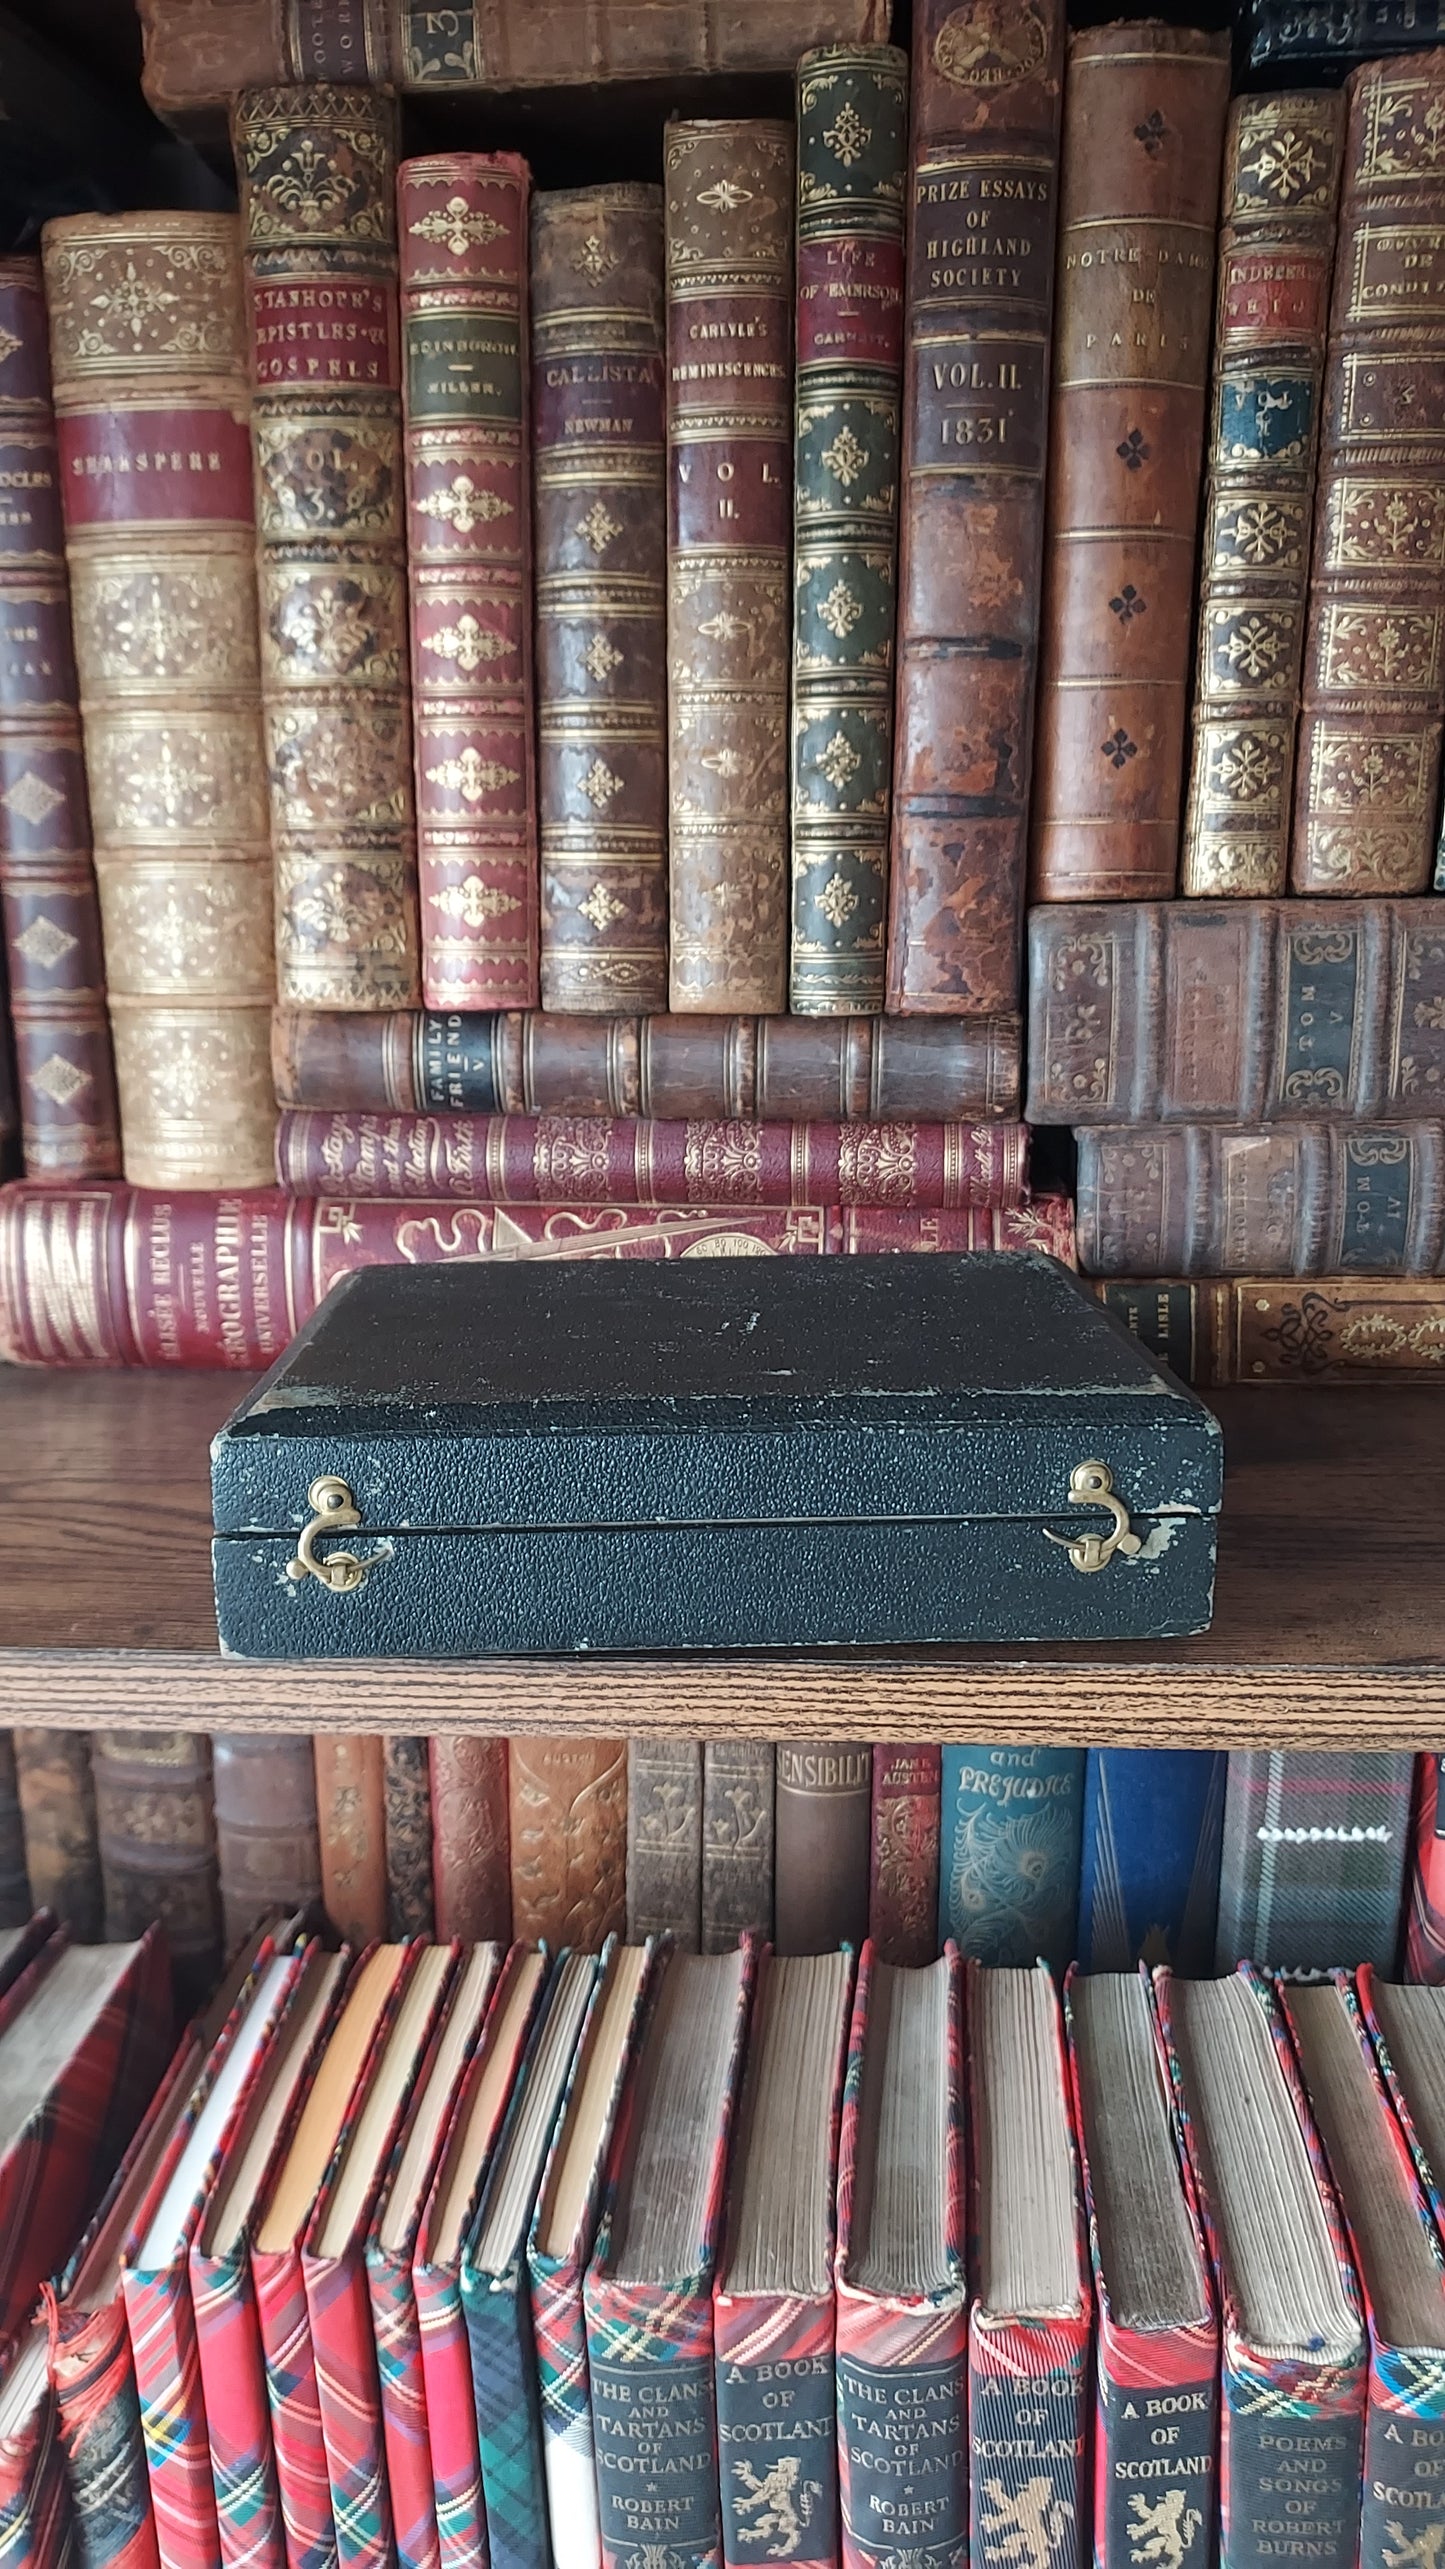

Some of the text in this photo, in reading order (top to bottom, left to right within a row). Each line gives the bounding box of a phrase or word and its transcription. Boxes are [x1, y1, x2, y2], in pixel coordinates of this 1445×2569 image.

[917, 180, 1047, 203] PRIZE ESSAYS
[966, 210, 991, 229] OF
[927, 237, 1032, 260] HIGHLAND
[827, 251, 875, 267] LIFE
[1066, 248, 1140, 270] NOTRE
[1405, 254, 1433, 268] DE
[931, 269, 1021, 289] SOCIETY
[254, 288, 382, 313] STANHOPE'S
[800, 285, 818, 299] OF
[1133, 288, 1155, 303] DE
[689, 319, 768, 339] CARLYLE'S
[1087, 333, 1188, 349] PARIS
[257, 357, 378, 378] GOSPELS
[546, 364, 652, 387] CALLISTA
[933, 363, 993, 391] VOL.
[565, 418, 634, 434] NEWMAN
[941, 417, 1007, 446] 1831
[428, 1019, 445, 1101] FAMILY
[447, 1014, 464, 1108] FRIEND
[472, 1059, 485, 1072] V
[150, 1203, 173, 1285] RECLUS
[250, 1214, 275, 1355] UNIVERSELLE
[1157, 1293, 1169, 1339] LISLE
[890, 1757, 932, 1771] JANE
[990, 1747, 1041, 1767] and
[777, 1749, 870, 1787] ENSIBILIT
[882, 1769, 938, 1785] AUSTEN
[725, 2357, 829, 2385] A BOOK
[592, 2379, 713, 2403] THE CLANS
[844, 2374, 964, 2405] THE CLANS
[980, 2374, 1085, 2398] A BOOK
[762, 2390, 796, 2409] OF
[1121, 2392, 1208, 2420] A BOOK
[629, 2406, 669, 2419] AND
[886, 2408, 926, 2420] AND
[1015, 2409, 1048, 2426] OF
[598, 2417, 706, 2440] TARTANS
[720, 2416, 834, 2442] SCOTLAND
[851, 2413, 961, 2442] TARTANS
[1151, 2425, 1181, 2445] OF
[1384, 2424, 1403, 2444] A
[638, 2442, 664, 2455] OF
[895, 2443, 920, 2456] OF
[971, 2435, 1084, 2460] SCOTLAND
[1260, 2435, 1348, 2452] POEMS
[596, 2450, 712, 2474] SCOTLAND
[851, 2447, 964, 2477] SCOTLAND
[1115, 2454, 1212, 2479] SCOTLAND
[1277, 2458, 1326, 2473] AND
[1259, 2477, 1343, 2493] SONGS
[611, 2495, 694, 2514] ROBERT
[1373, 2481, 1445, 2510] SCOTL
[869, 2495, 950, 2517] ROBERT
[1284, 2499, 1315, 2515] OF
[627, 2514, 680, 2531] BAIN
[883, 2518, 935, 2535] BAIN
[1252, 2518, 1346, 2535] ROBERT
[1256, 2539, 1337, 2557] BURNS
